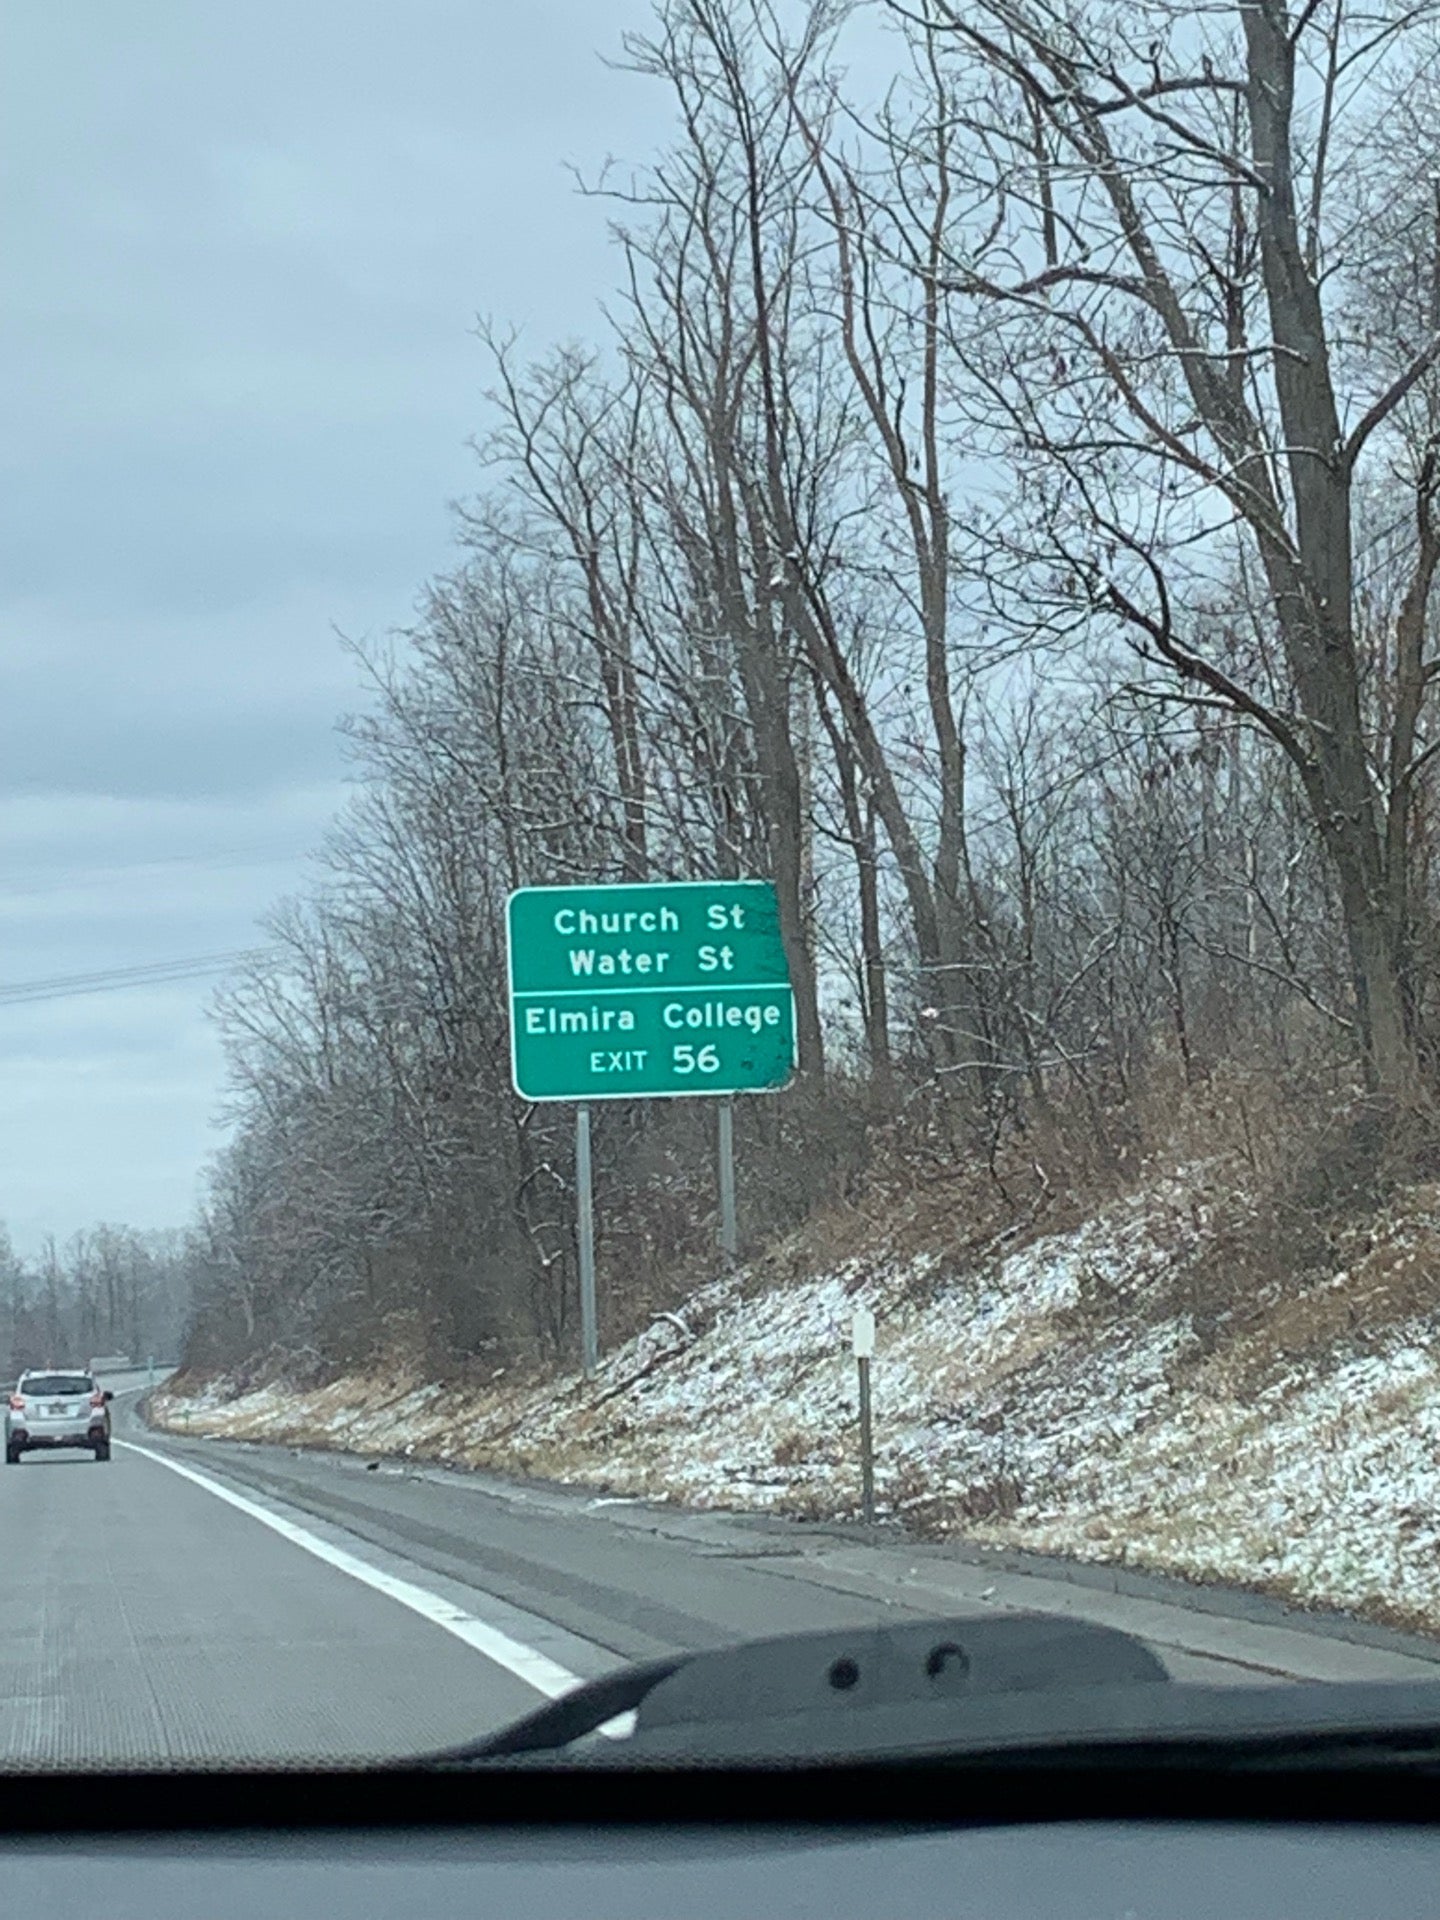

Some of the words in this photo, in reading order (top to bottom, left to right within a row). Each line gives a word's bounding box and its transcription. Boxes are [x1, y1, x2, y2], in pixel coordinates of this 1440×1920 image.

[554, 907, 679, 934] Church
[707, 904, 745, 930] St
[569, 949, 669, 975] Water
[697, 945, 734, 971] St
[525, 1006, 634, 1033] Elmira
[663, 1002, 781, 1033] College
[590, 1050, 648, 1073] EXIT
[672, 1044, 720, 1073] 56
